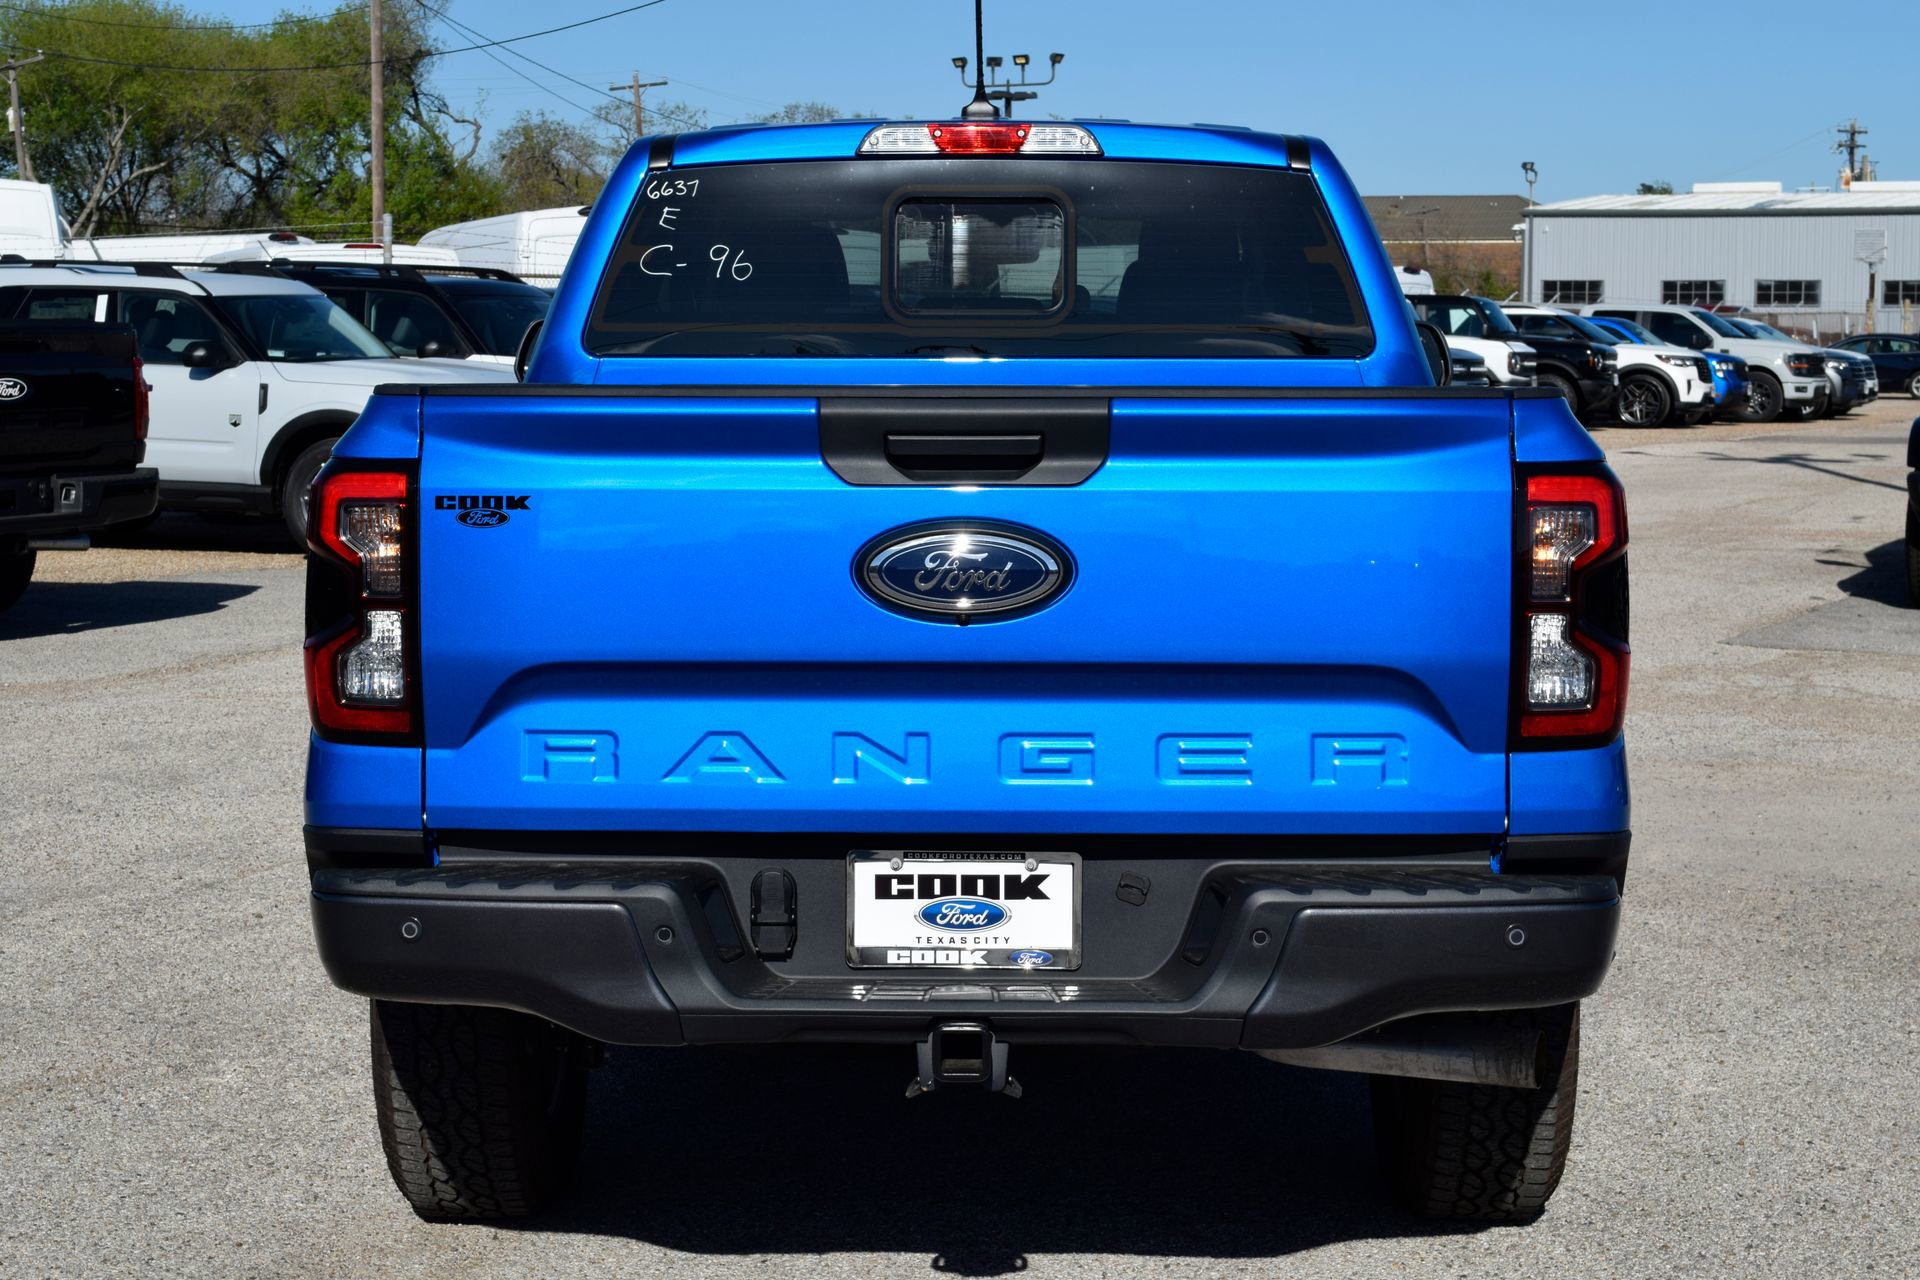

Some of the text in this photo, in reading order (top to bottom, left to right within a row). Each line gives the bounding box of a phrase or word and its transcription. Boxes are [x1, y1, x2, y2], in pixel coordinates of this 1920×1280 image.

[646, 179, 699, 200] 6637
[659, 206, 681, 231] E
[434, 495, 532, 511] COOK
[466, 510, 500, 525] Ford
[914, 549, 1014, 592] Ford
[521, 728, 1409, 787] RANGER
[874, 873, 1051, 900] COOK
[936, 903, 989, 926] Ford
[915, 936, 1011, 945] TEXAS CITY
[887, 949, 1044, 965] COOK Ford
